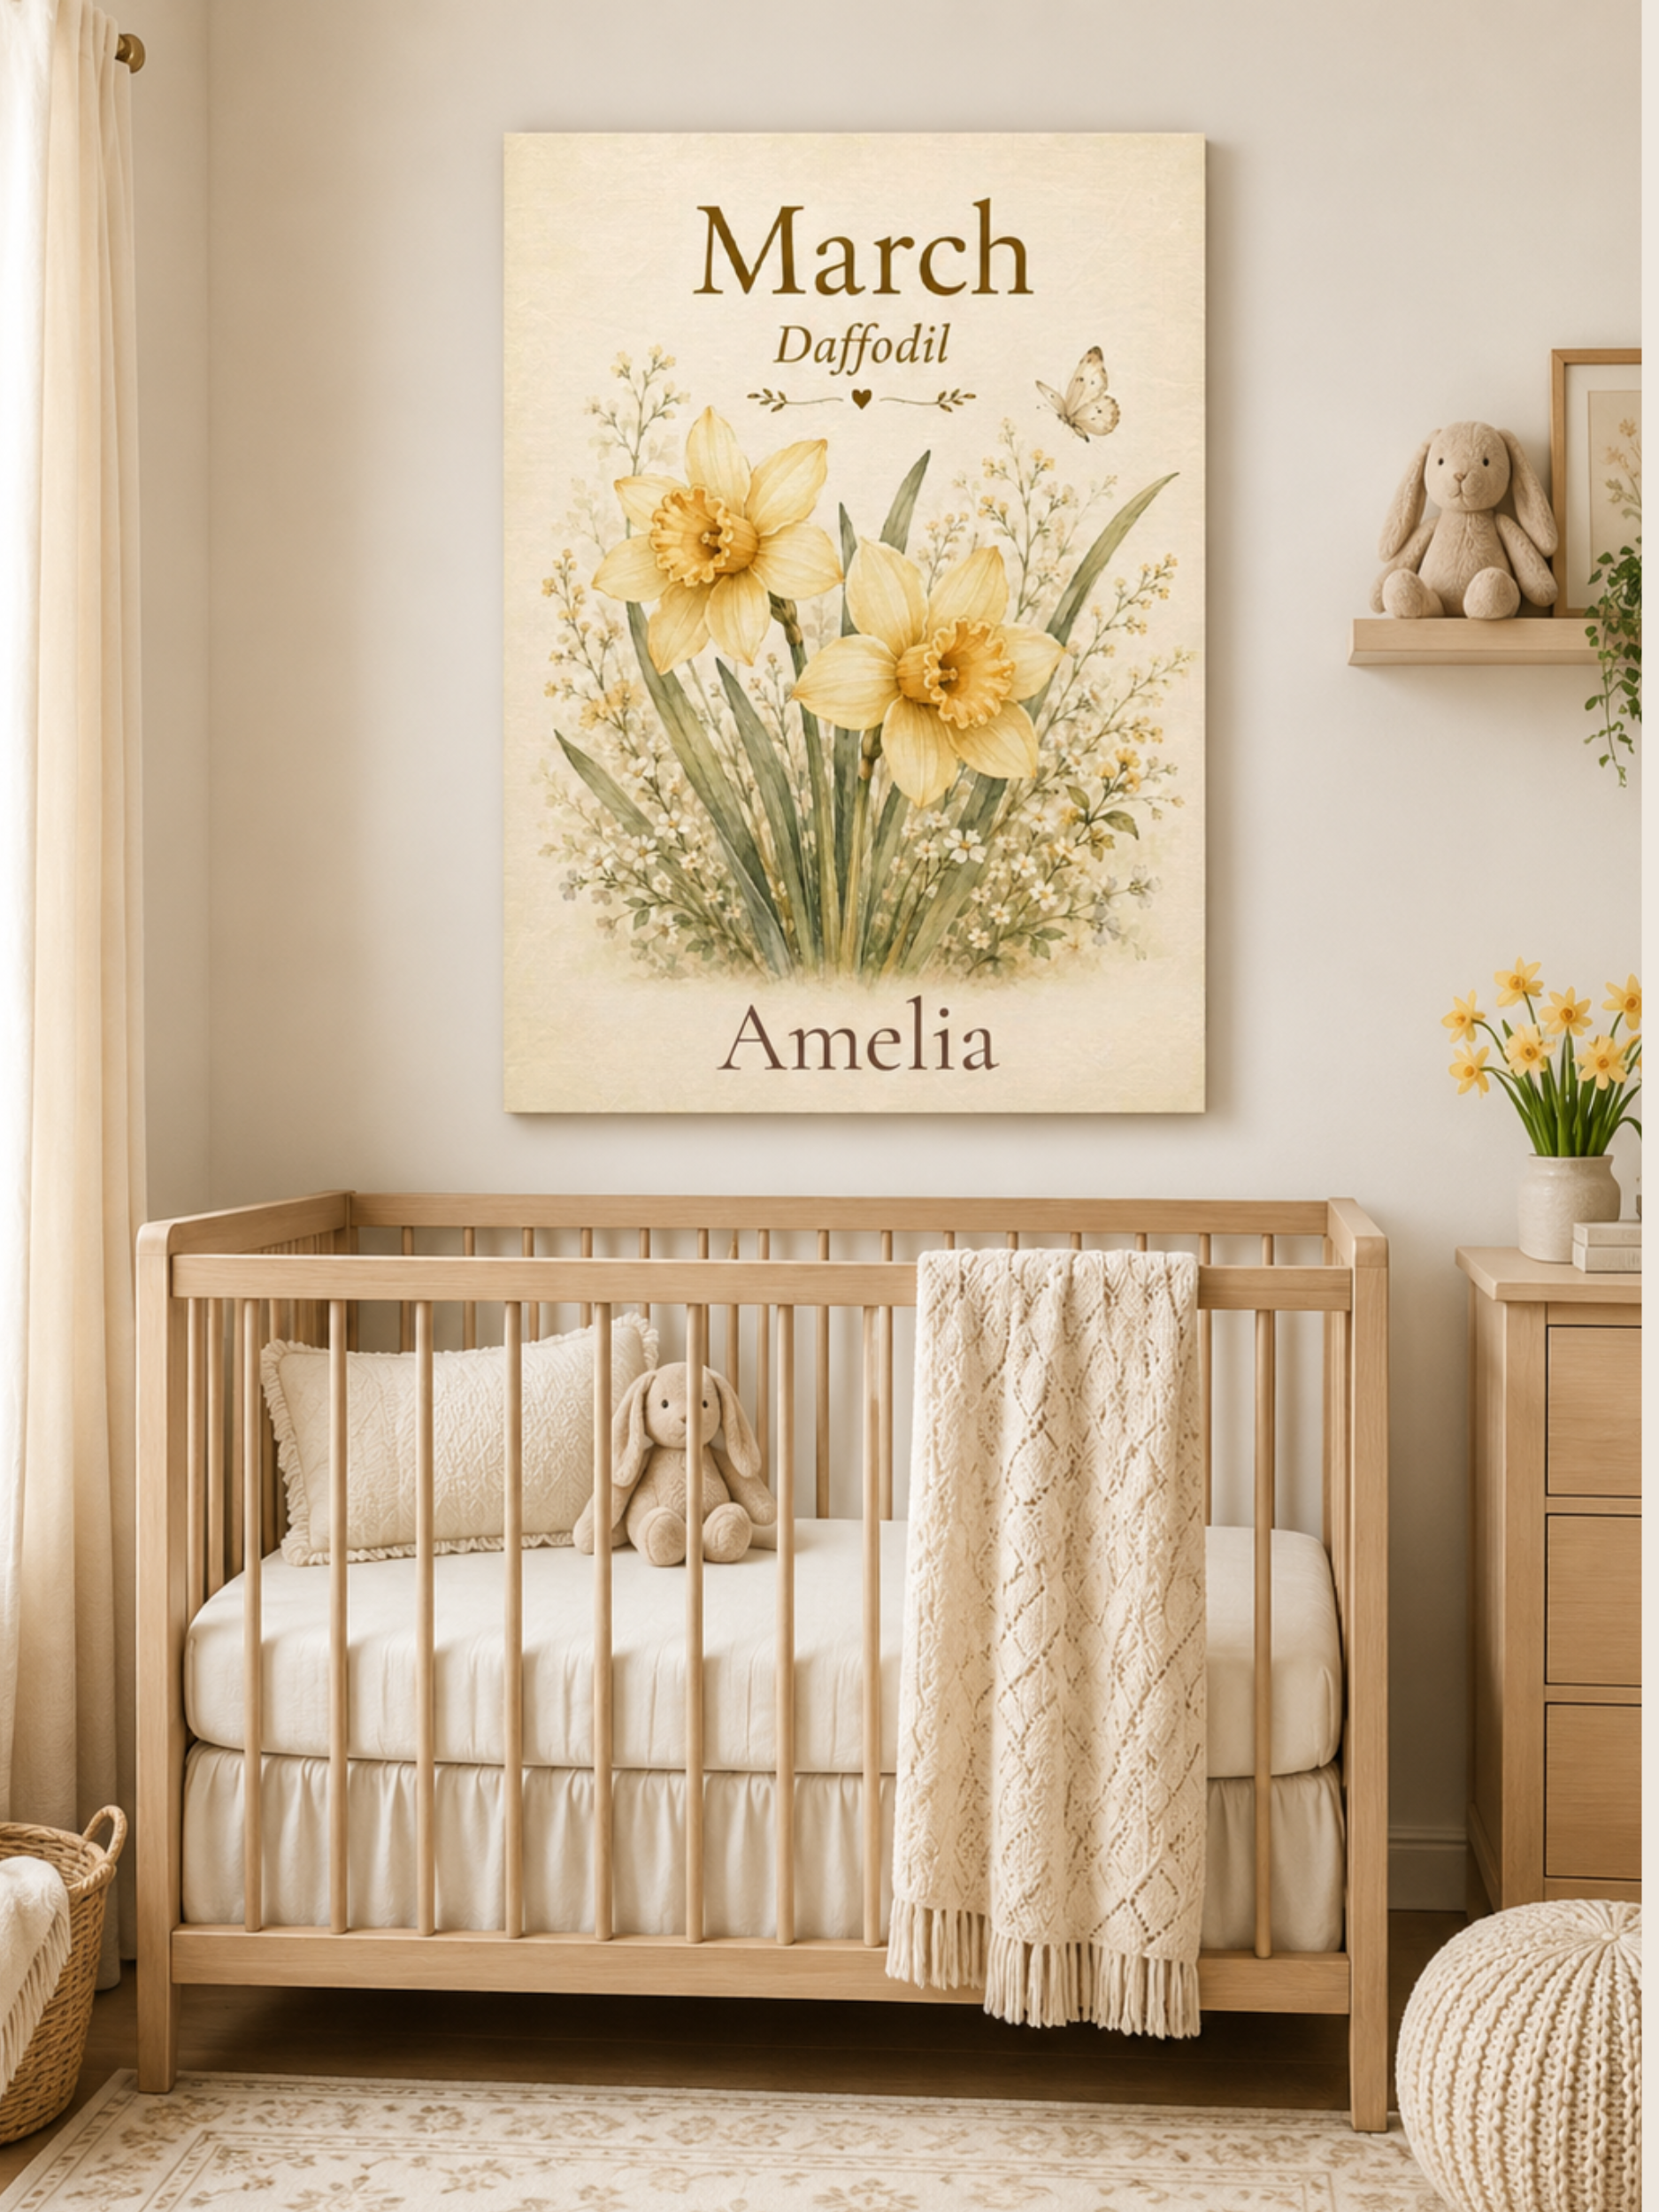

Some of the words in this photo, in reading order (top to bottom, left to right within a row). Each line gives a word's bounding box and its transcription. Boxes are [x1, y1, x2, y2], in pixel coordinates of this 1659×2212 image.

[694, 198, 1033, 296] March
[774, 323, 950, 376] Daffodil
[718, 995, 999, 1071] Amelia
